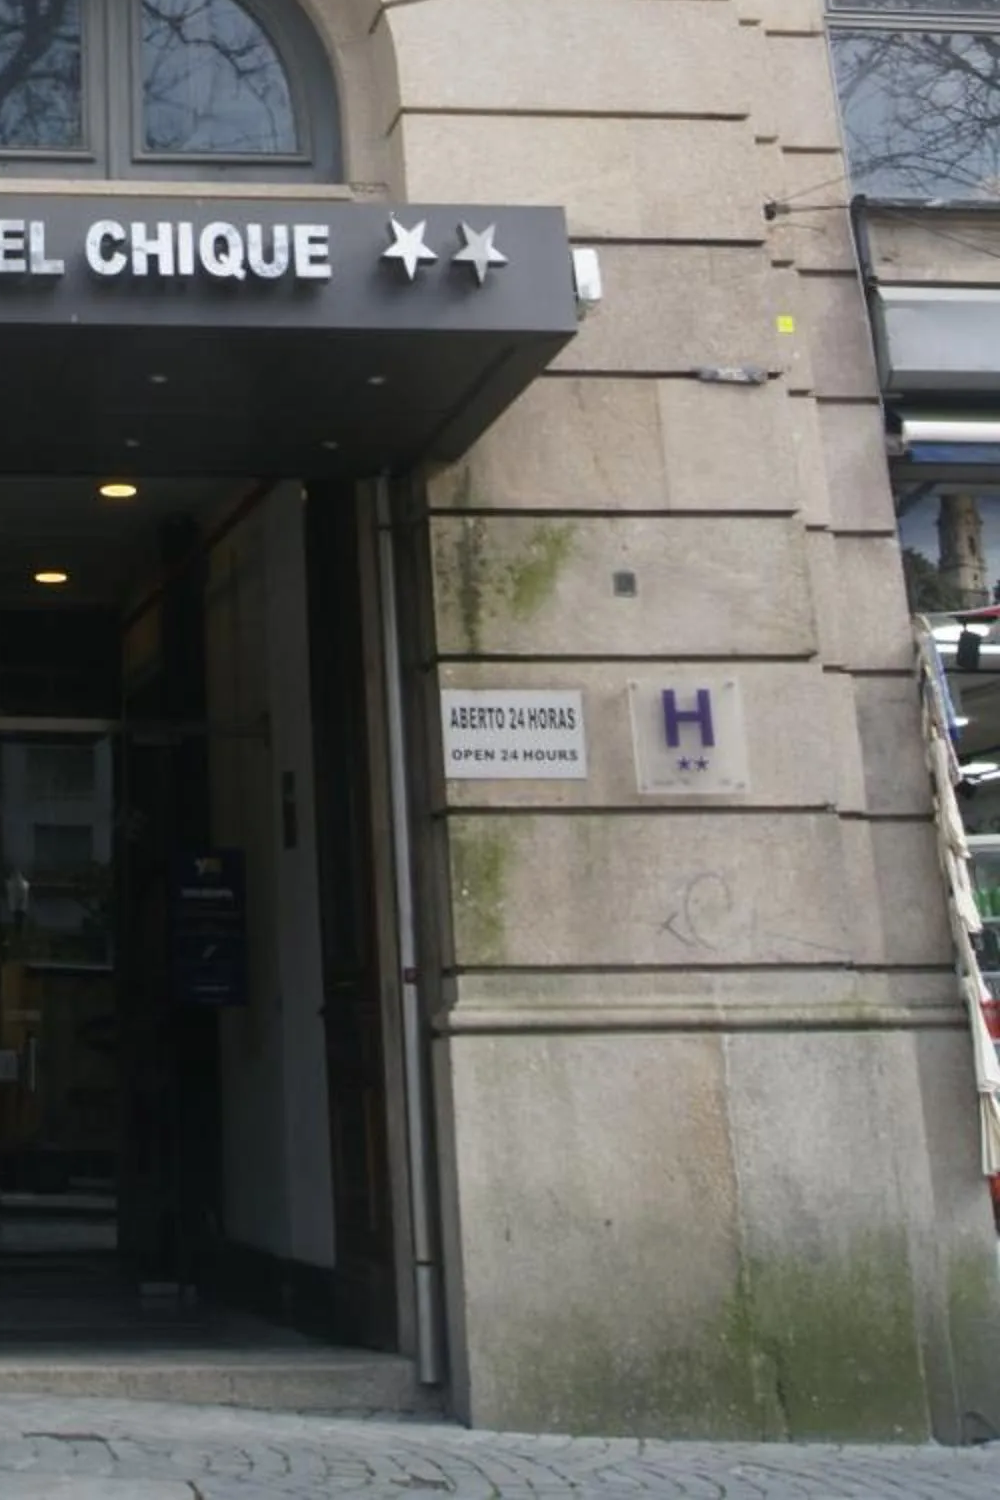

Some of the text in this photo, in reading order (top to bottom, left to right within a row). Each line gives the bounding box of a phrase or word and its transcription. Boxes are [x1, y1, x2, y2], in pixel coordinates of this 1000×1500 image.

[86, 220, 332, 281] CHIQUE
[451, 707, 577, 731] ABERTO 24 HORAS
[661, 688, 716, 748] H
[452, 749, 579, 763] OPEN 24 HOURS
